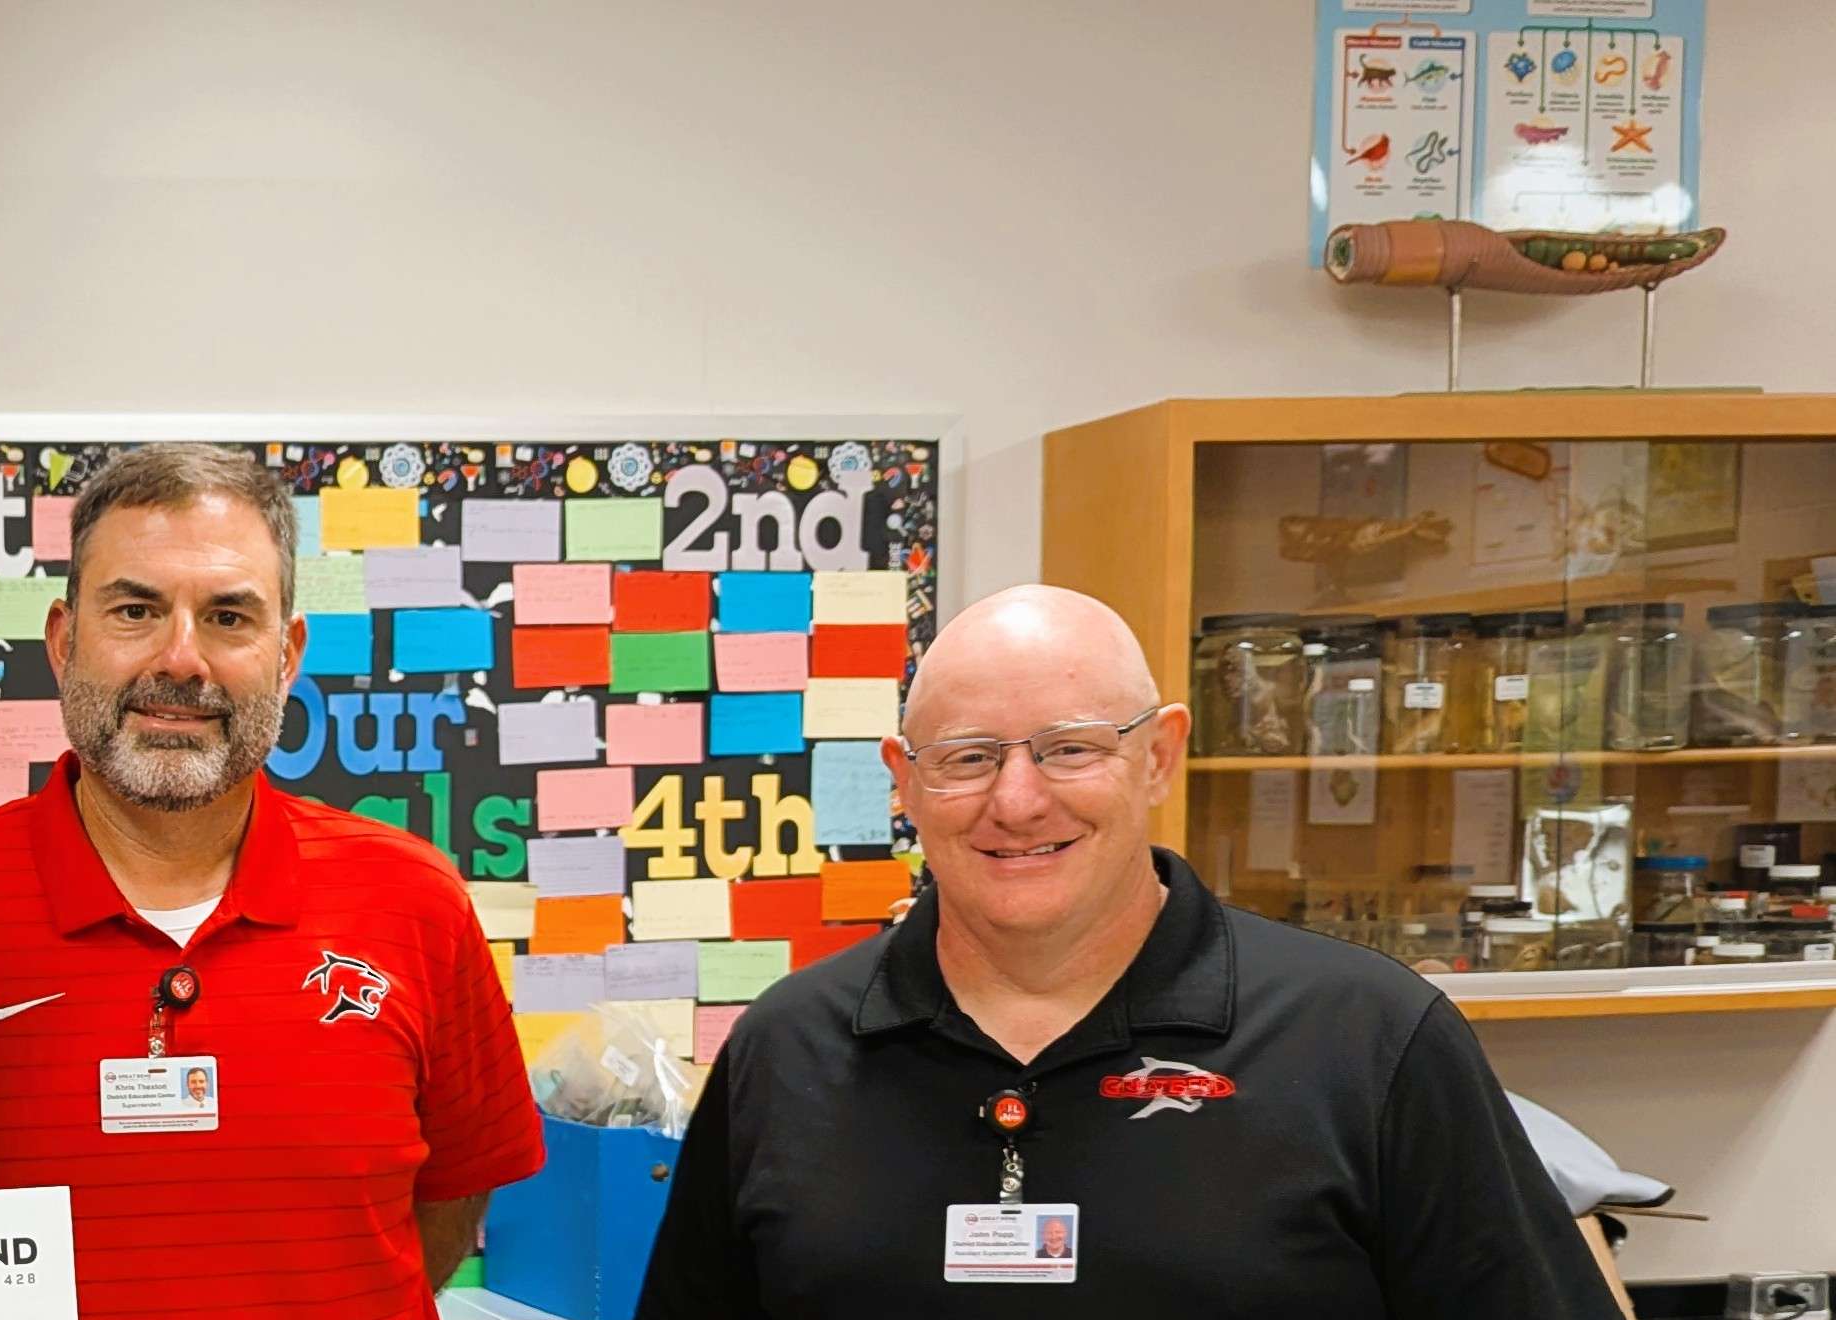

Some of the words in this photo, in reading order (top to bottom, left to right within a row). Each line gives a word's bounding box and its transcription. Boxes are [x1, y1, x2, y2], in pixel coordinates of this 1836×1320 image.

[662, 464, 874, 572] 2nd
[264, 675, 468, 780] Our
[618, 775, 827, 879] 4th
[3, 1272, 37, 1286] 428
